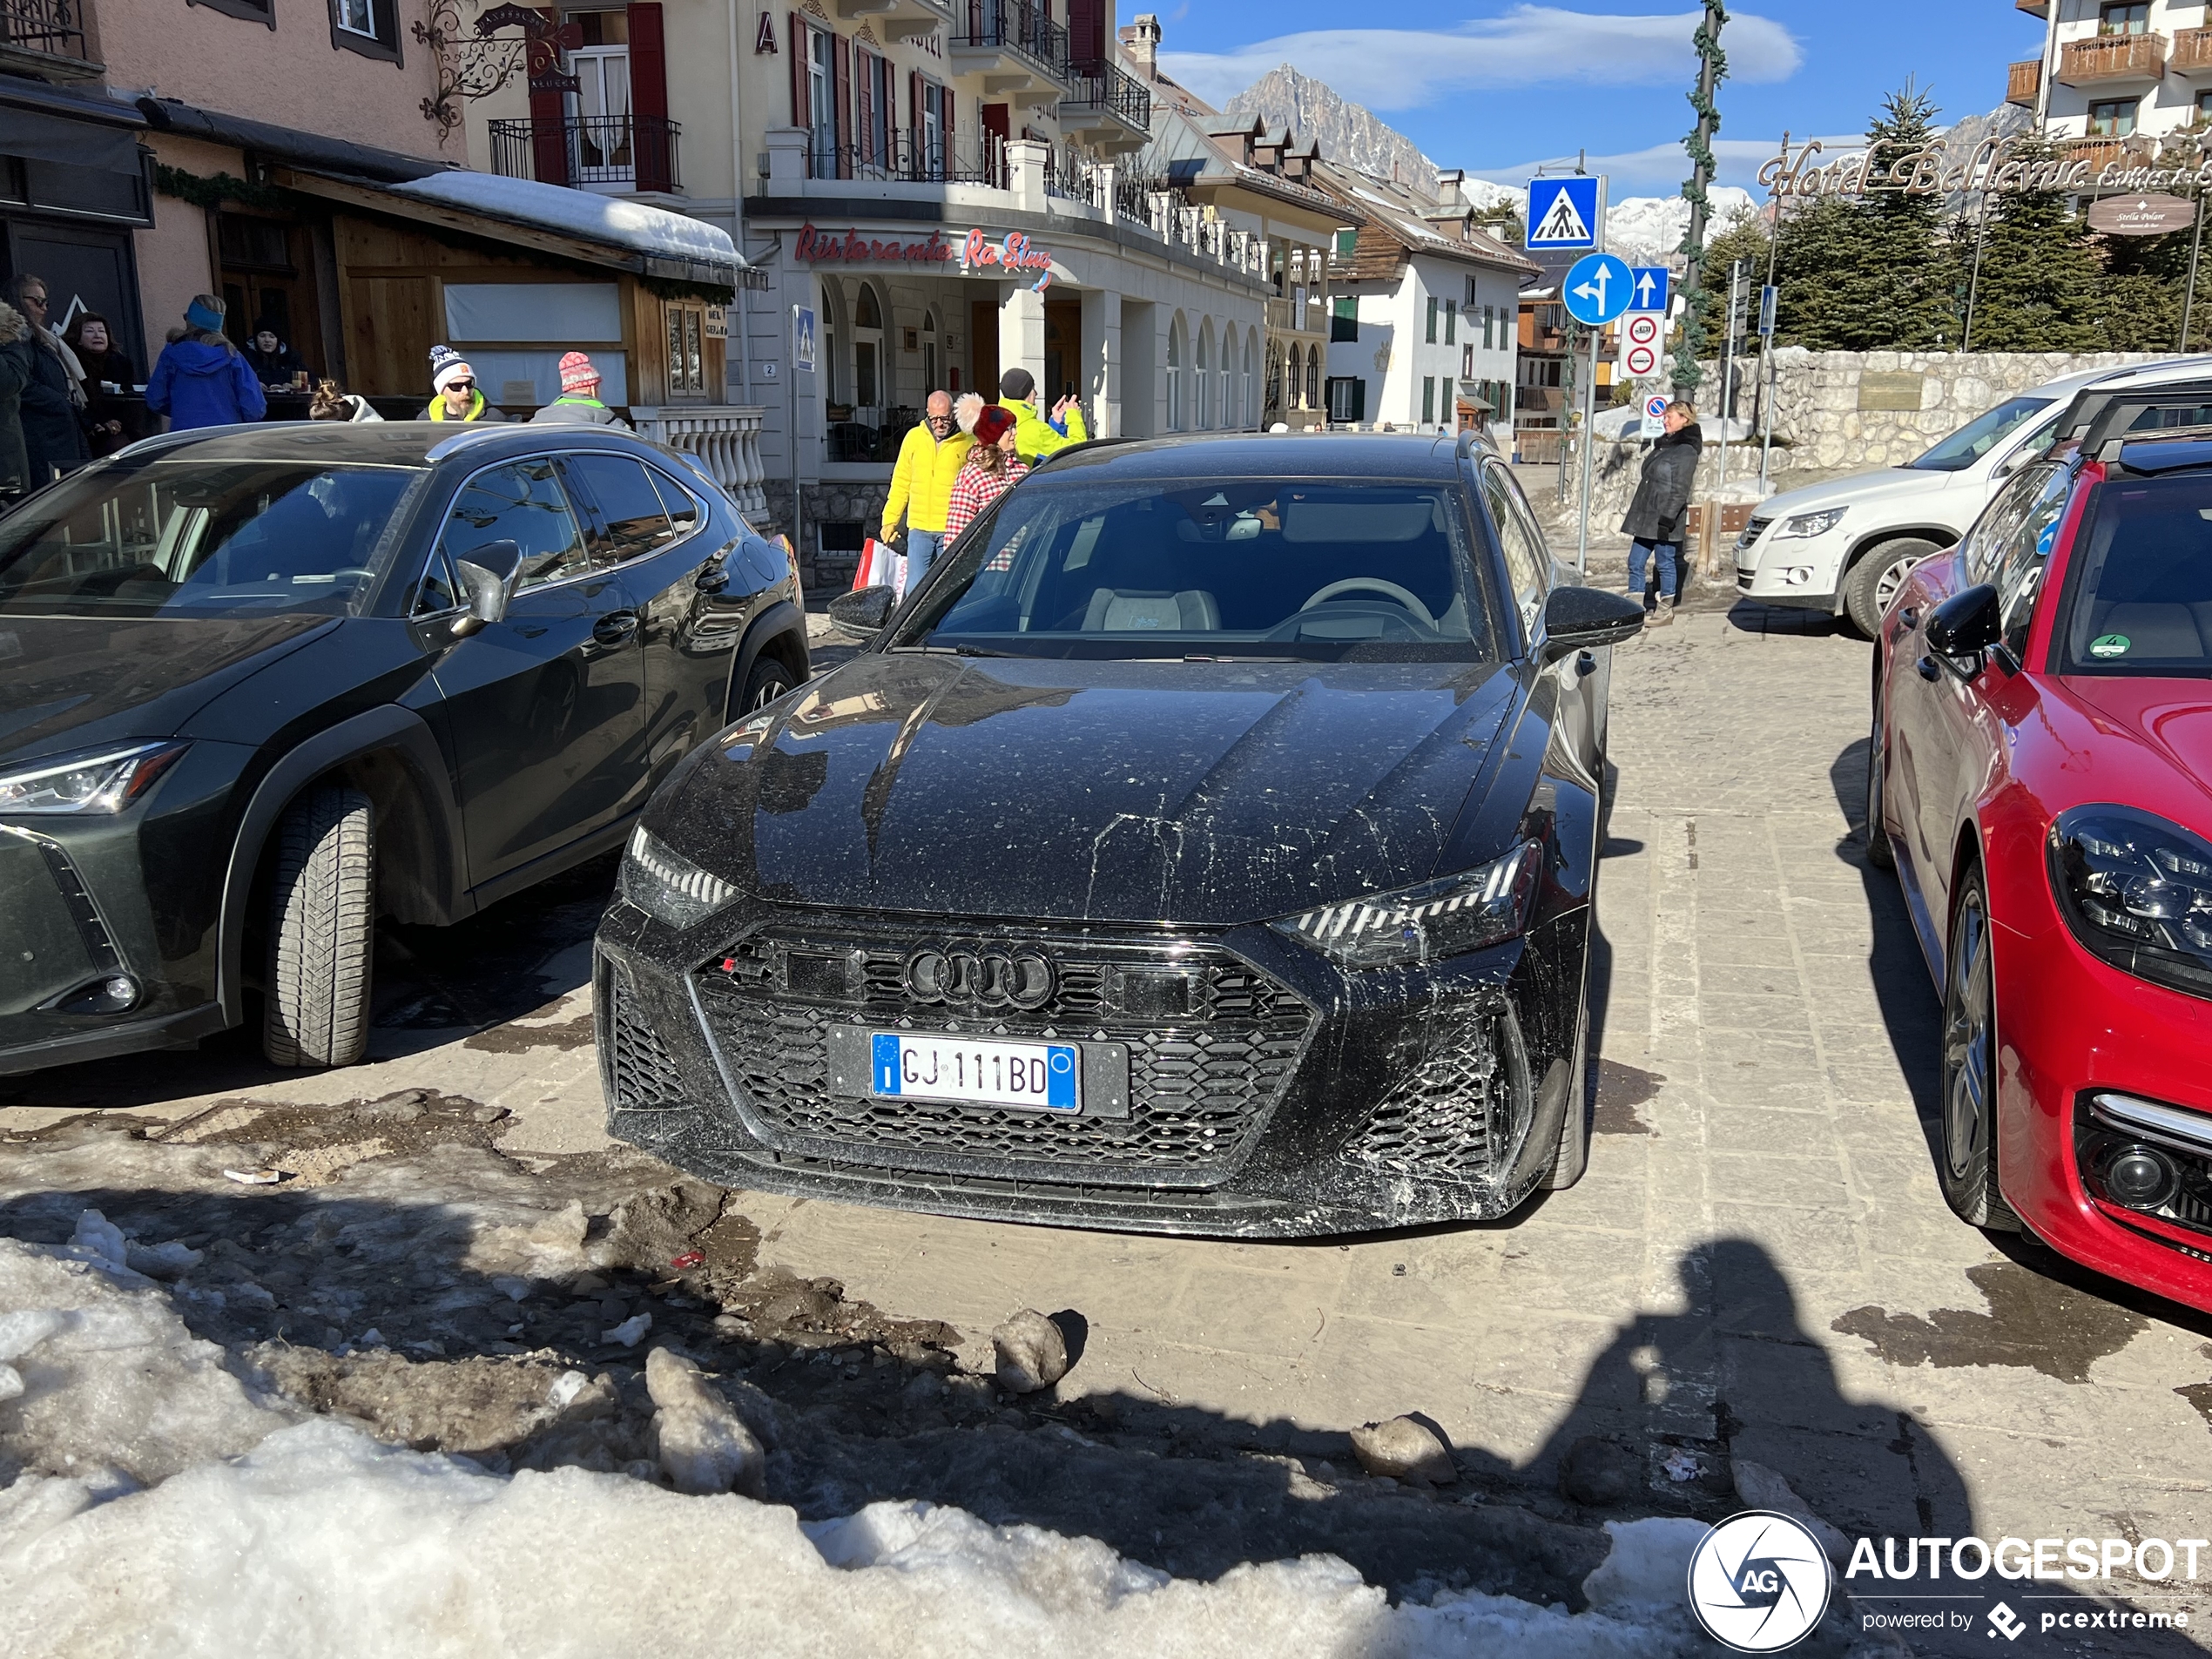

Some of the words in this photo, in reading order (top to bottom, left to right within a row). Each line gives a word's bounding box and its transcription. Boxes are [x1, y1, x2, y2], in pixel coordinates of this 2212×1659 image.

[1757, 138, 1893, 197] Hotel
[1889, 136, 2093, 194] Bellevue
[2115, 212, 2140, 222] Stella
[2141, 211, 2166, 221] Polare
[794, 222, 953, 262] Ristorante
[961, 228, 998, 267] Ra
[1001, 231, 1054, 270] Stua
[766, 365, 772, 374] 2
[2105, 635, 2117, 646] 4
